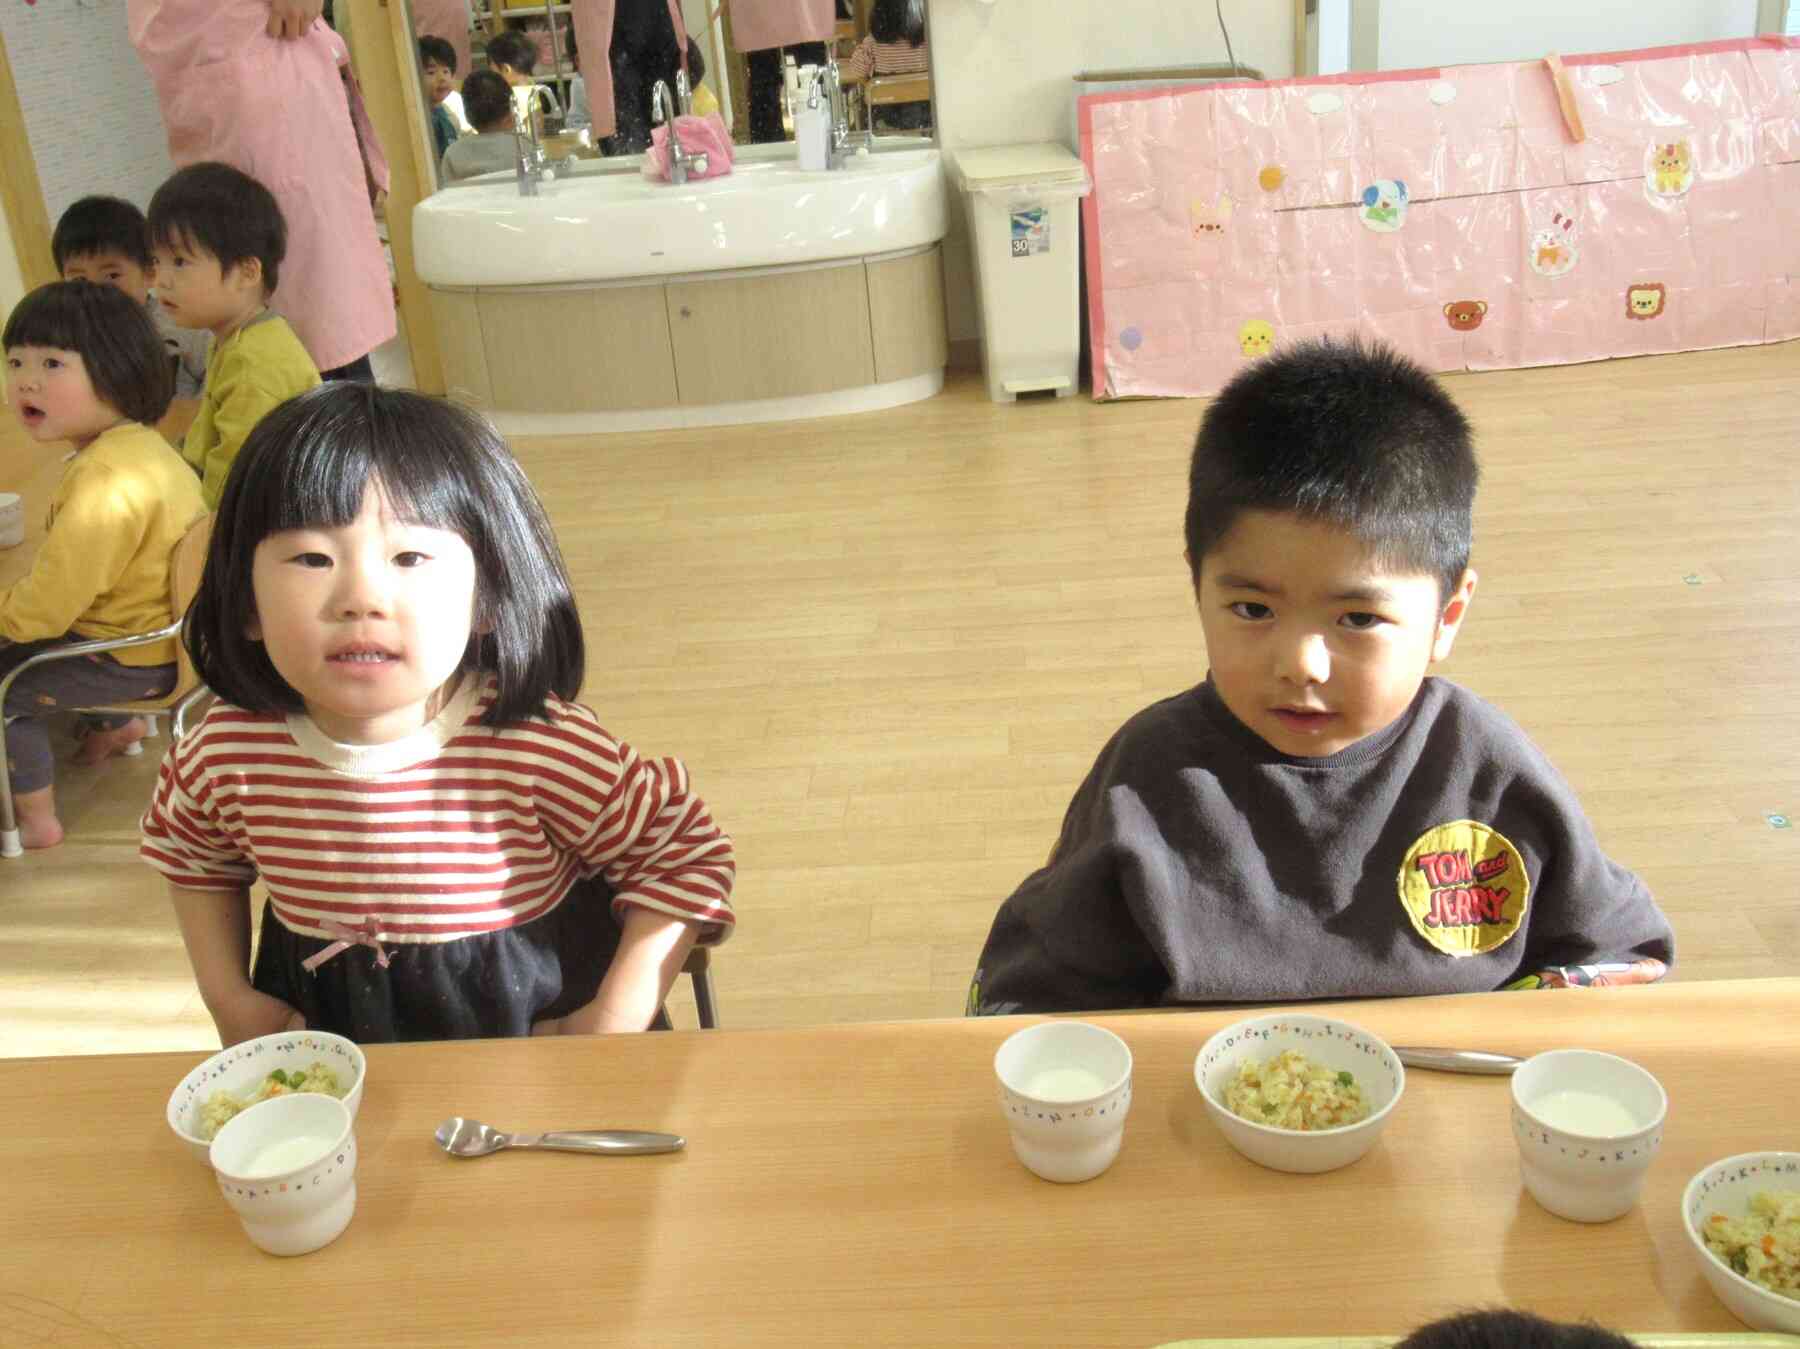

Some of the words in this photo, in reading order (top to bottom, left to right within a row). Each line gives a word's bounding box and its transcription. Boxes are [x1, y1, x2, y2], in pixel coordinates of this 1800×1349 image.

[1013, 239, 1028, 252] 30
[1416, 848, 1472, 888] TOM
[1474, 850, 1509, 882] and
[1423, 885, 1510, 928] JERRY
